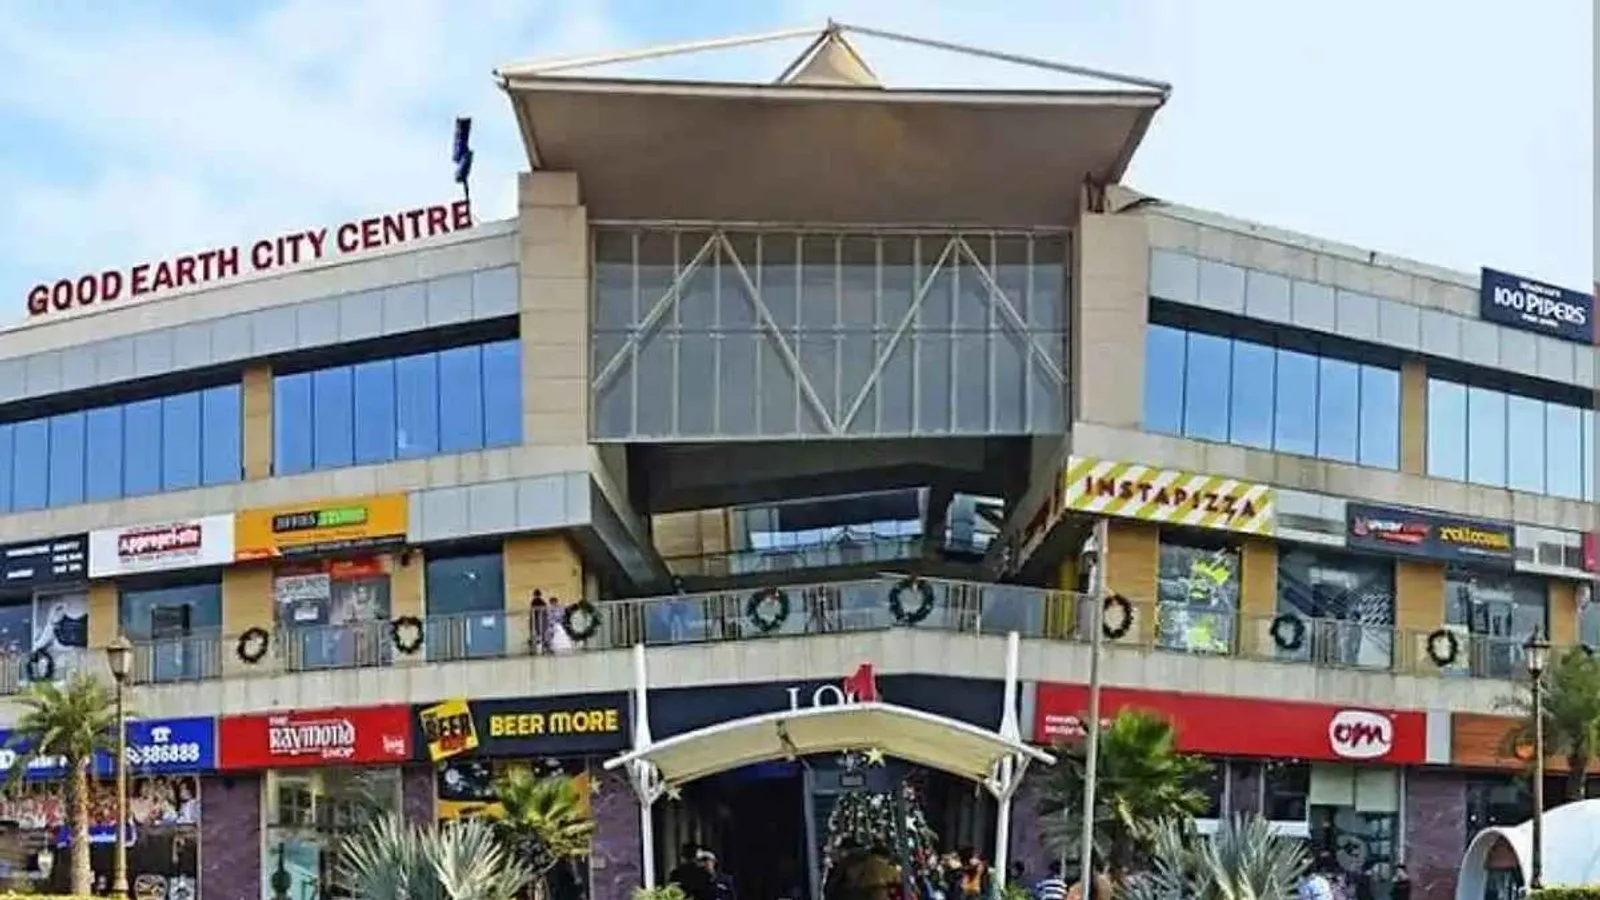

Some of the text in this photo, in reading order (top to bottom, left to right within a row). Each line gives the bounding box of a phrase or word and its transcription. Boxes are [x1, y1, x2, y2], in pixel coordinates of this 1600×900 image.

[27, 200, 473, 317] GOOD EARTH CITY CENTRE
[1494, 285, 1525, 310] 100
[1084, 475, 1256, 522] INSTAPIZZA
[489, 707, 620, 738] BEER MORE
